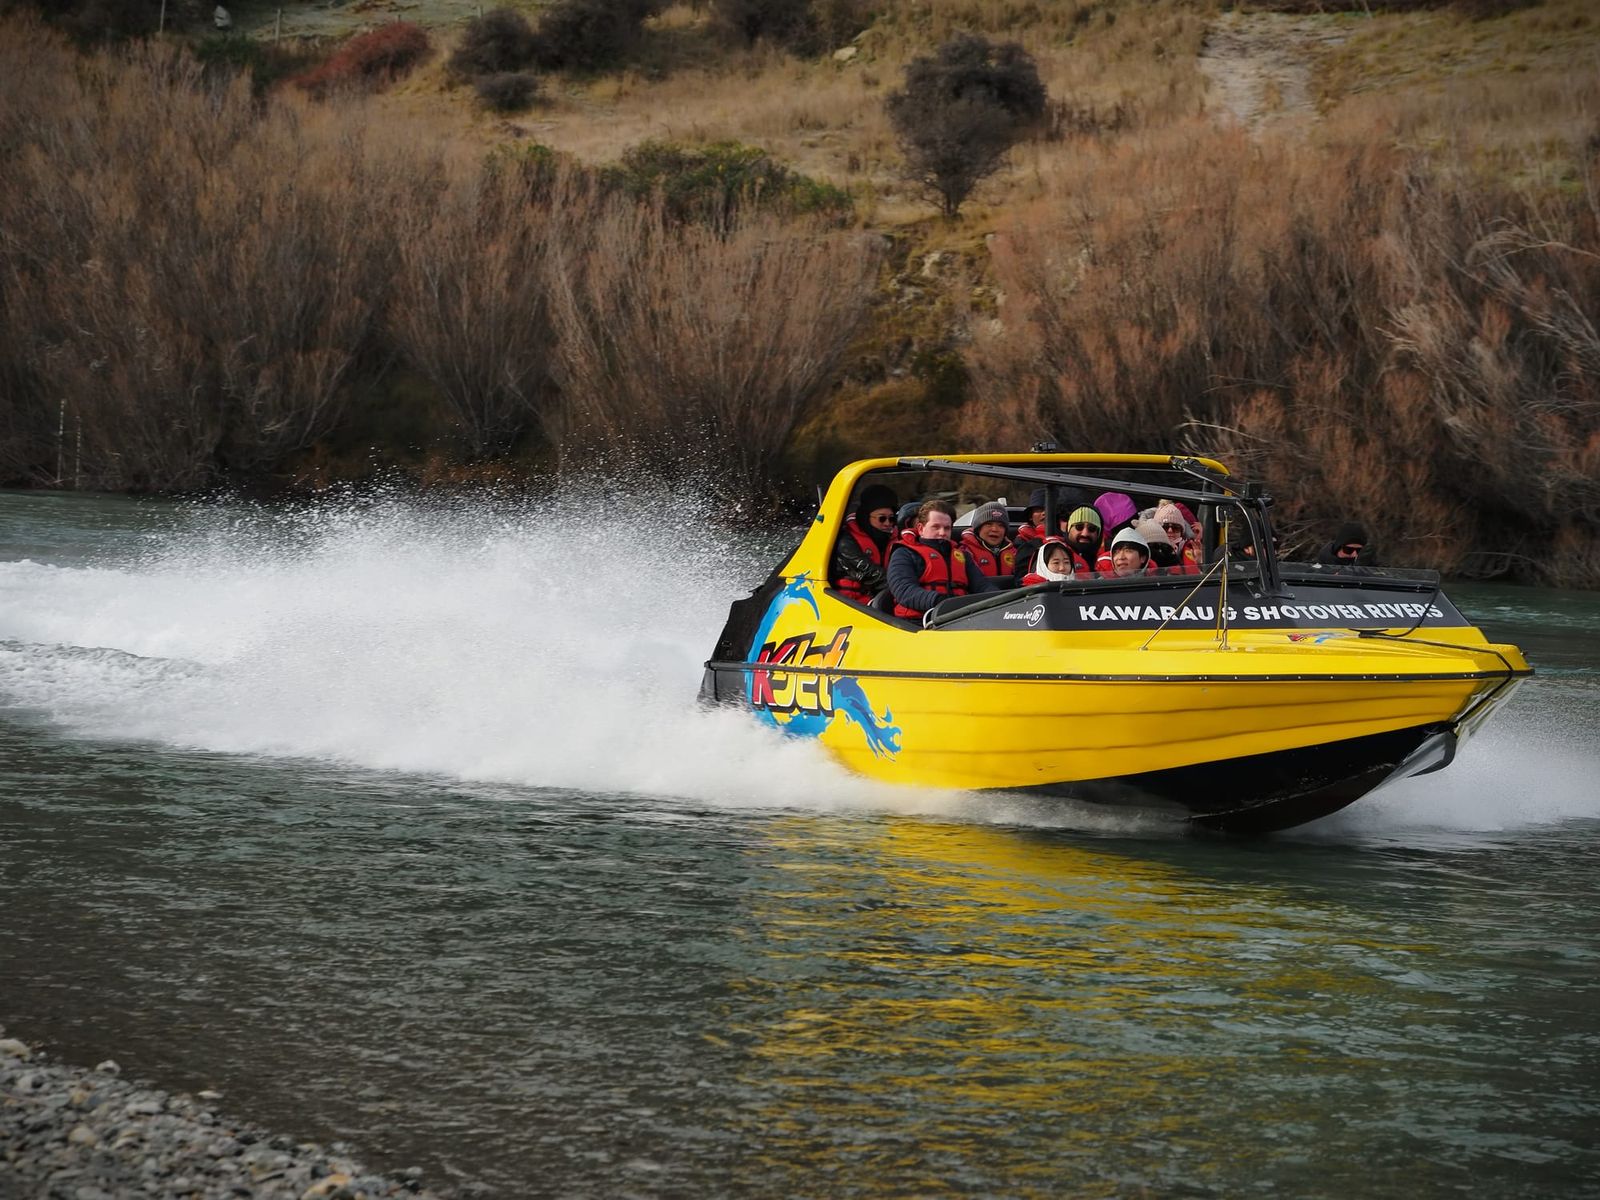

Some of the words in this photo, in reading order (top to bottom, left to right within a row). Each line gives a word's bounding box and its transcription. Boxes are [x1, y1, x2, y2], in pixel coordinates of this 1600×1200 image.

[1079, 605, 1215, 621] KAWARAU
[1222, 606, 1238, 621] &
[1243, 604, 1370, 620] SHOTOVER
[1363, 603, 1444, 618] RIVERS
